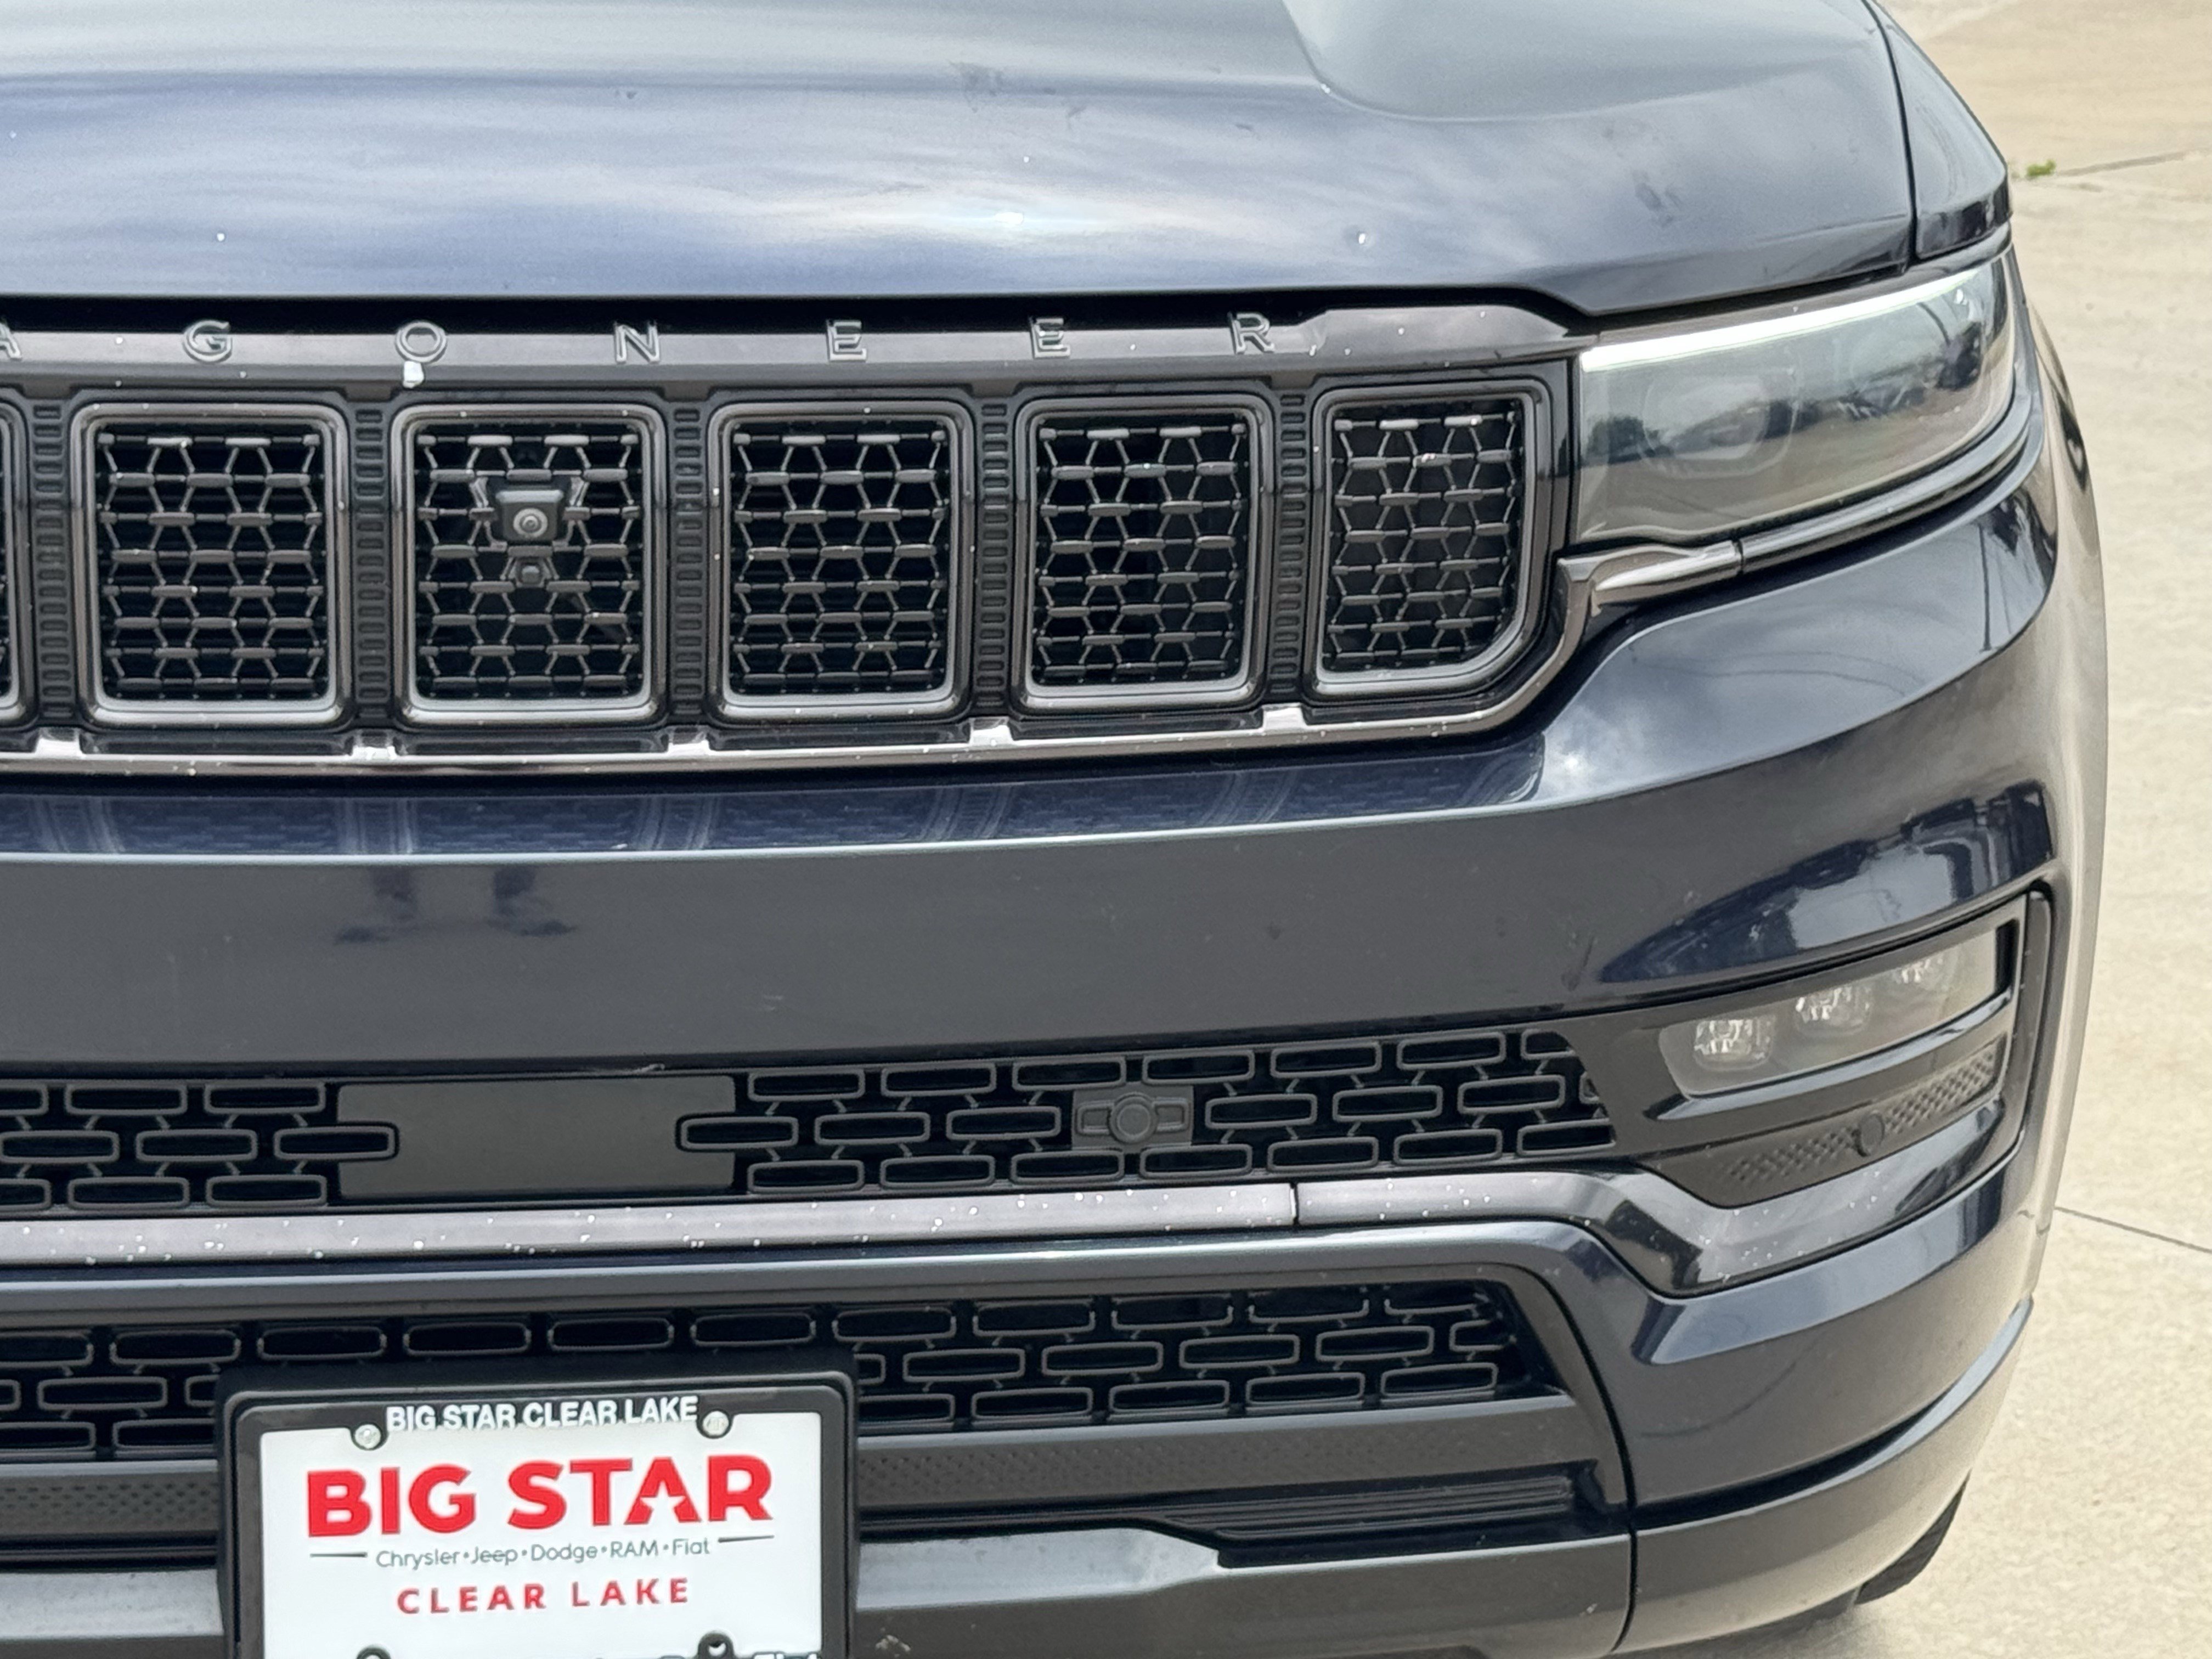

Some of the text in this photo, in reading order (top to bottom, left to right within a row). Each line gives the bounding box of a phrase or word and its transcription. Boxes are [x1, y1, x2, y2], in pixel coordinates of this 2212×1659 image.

[386, 1396, 698, 1431] BIG STAR CLEAR LAKE
[307, 1454, 773, 1537] BIG STAR
[396, 1577, 689, 1615] CLEAR LAKE
